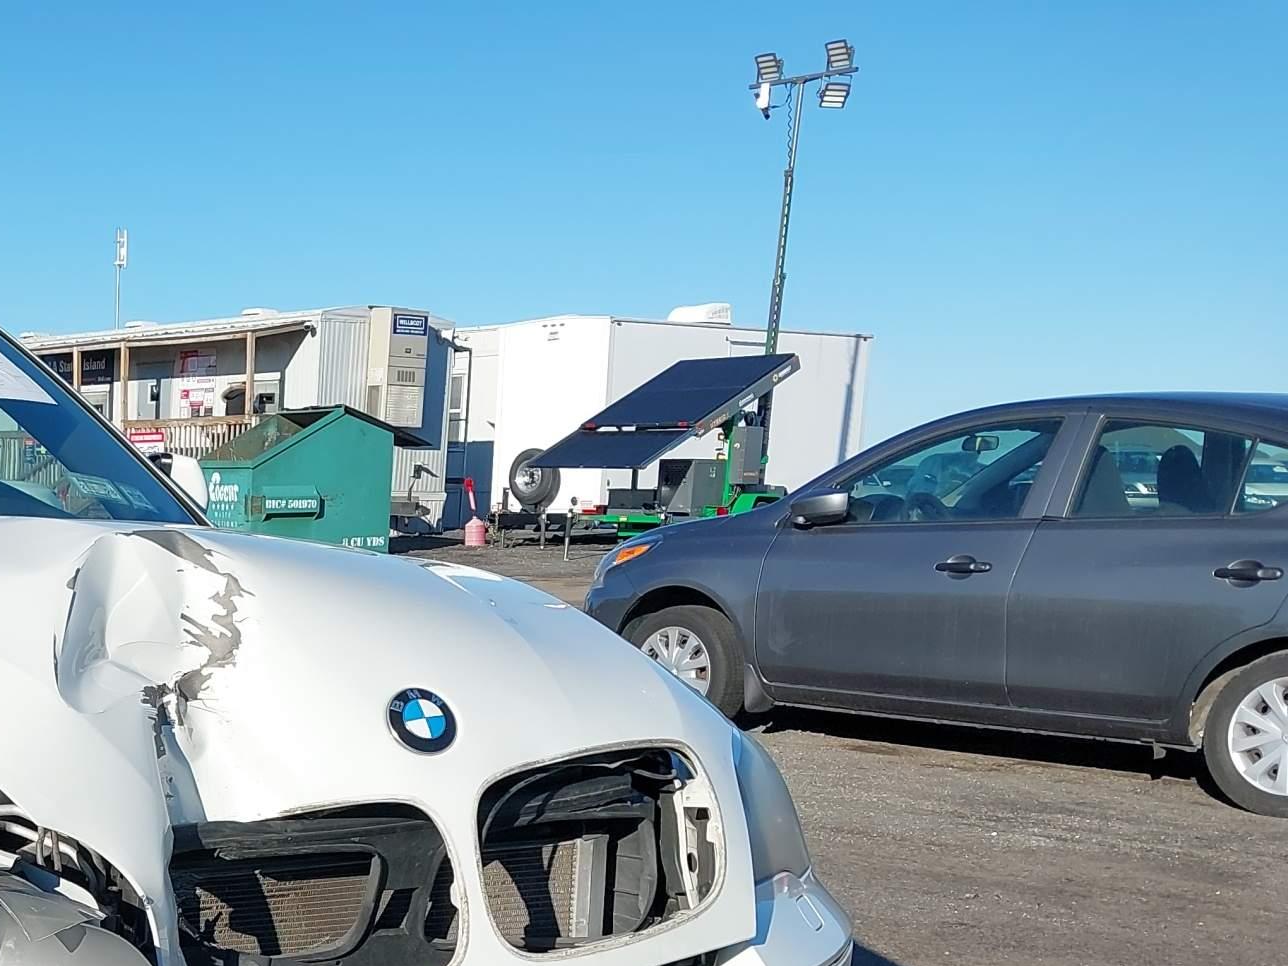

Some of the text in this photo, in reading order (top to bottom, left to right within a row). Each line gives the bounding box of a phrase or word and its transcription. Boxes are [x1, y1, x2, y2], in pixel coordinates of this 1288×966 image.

[83, 357, 106, 370] Island
[287, 499, 317, 509] 501970
[367, 536, 385, 547] YDS
[390, 689, 444, 712] BMW
